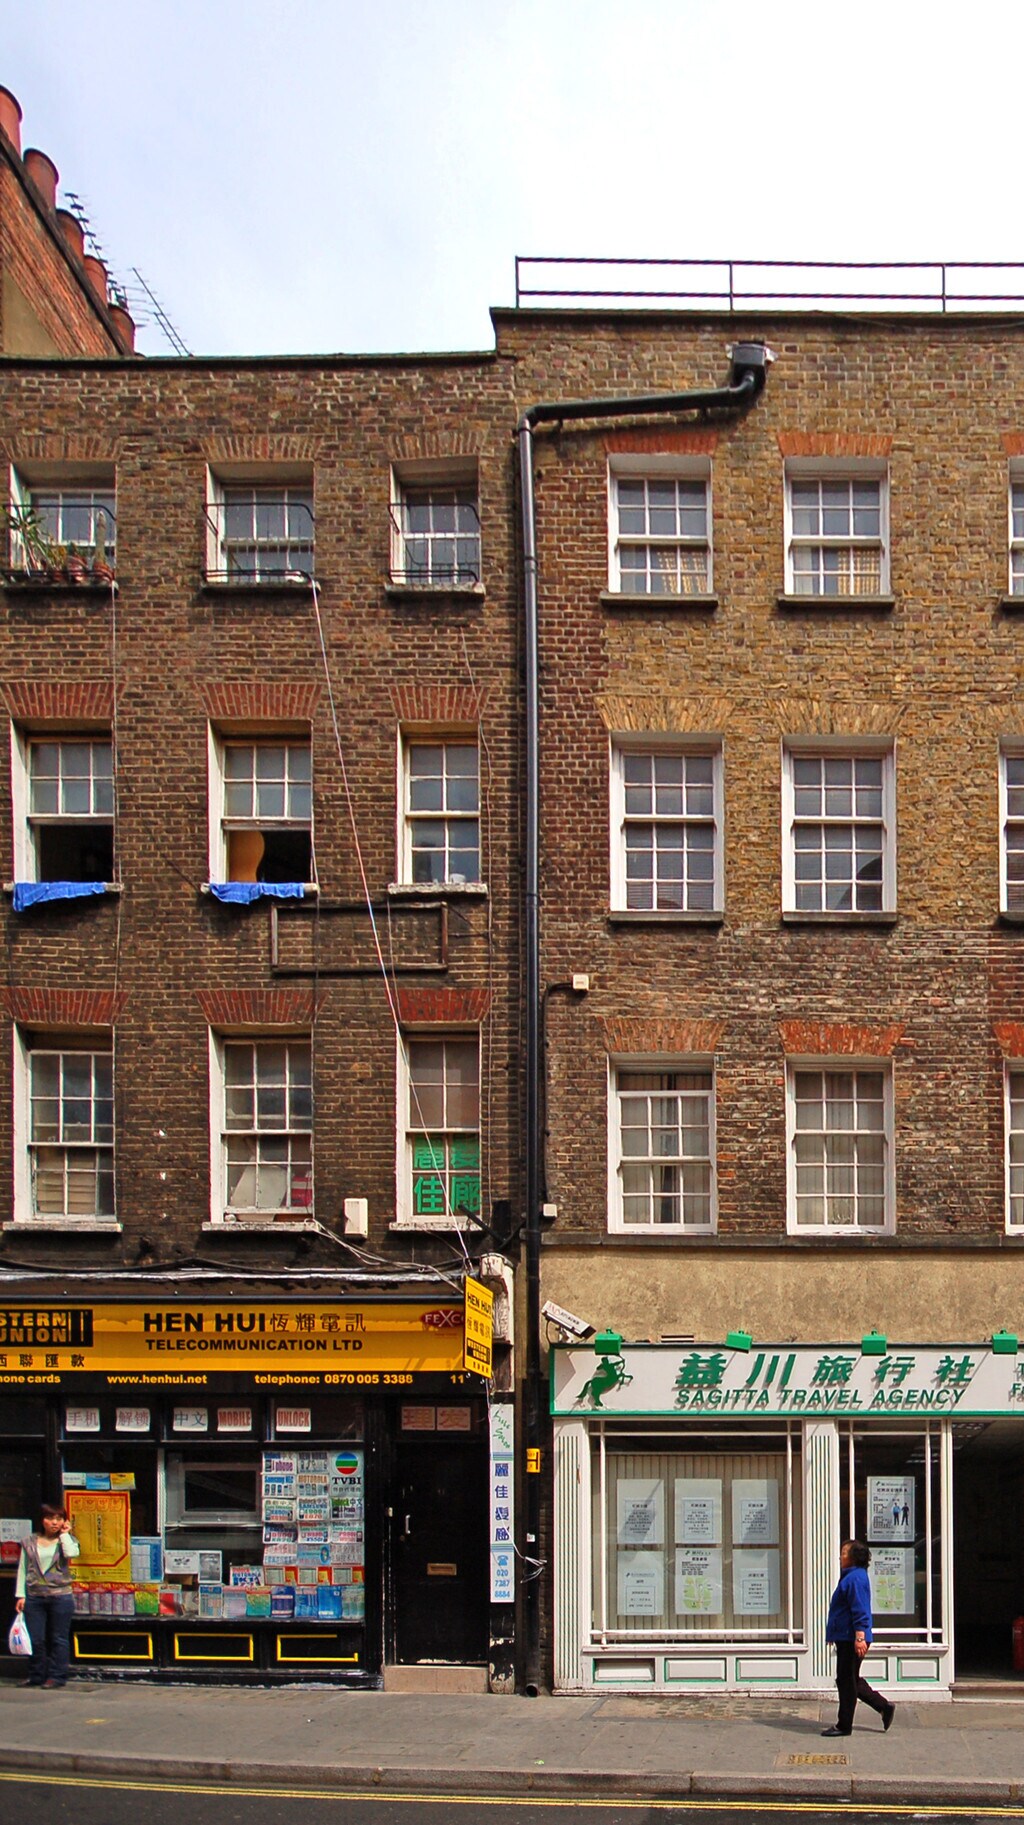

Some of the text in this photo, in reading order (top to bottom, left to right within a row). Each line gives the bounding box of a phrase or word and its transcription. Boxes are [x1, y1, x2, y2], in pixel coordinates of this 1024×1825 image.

[143, 1313, 266, 1332] HEN HUI
[425, 1310, 463, 1328] FEXC
[146, 1339, 363, 1350] TELECOMMUNICATION LTD
[675, 1352, 975, 1386] 益川旅行社
[27, 1373, 61, 1384] cards
[107, 1374, 208, 1384] www.henhui.net
[254, 1374, 320, 1386] telephone:
[324, 1374, 354, 1384] 0870
[356, 1374, 379, 1384] 005
[677, 1389, 966, 1405] SAGITTA TRAVEL AGENCY
[219, 1411, 309, 1427] MOBILE UNLOCK
[332, 1476, 361, 1485] TVBI
